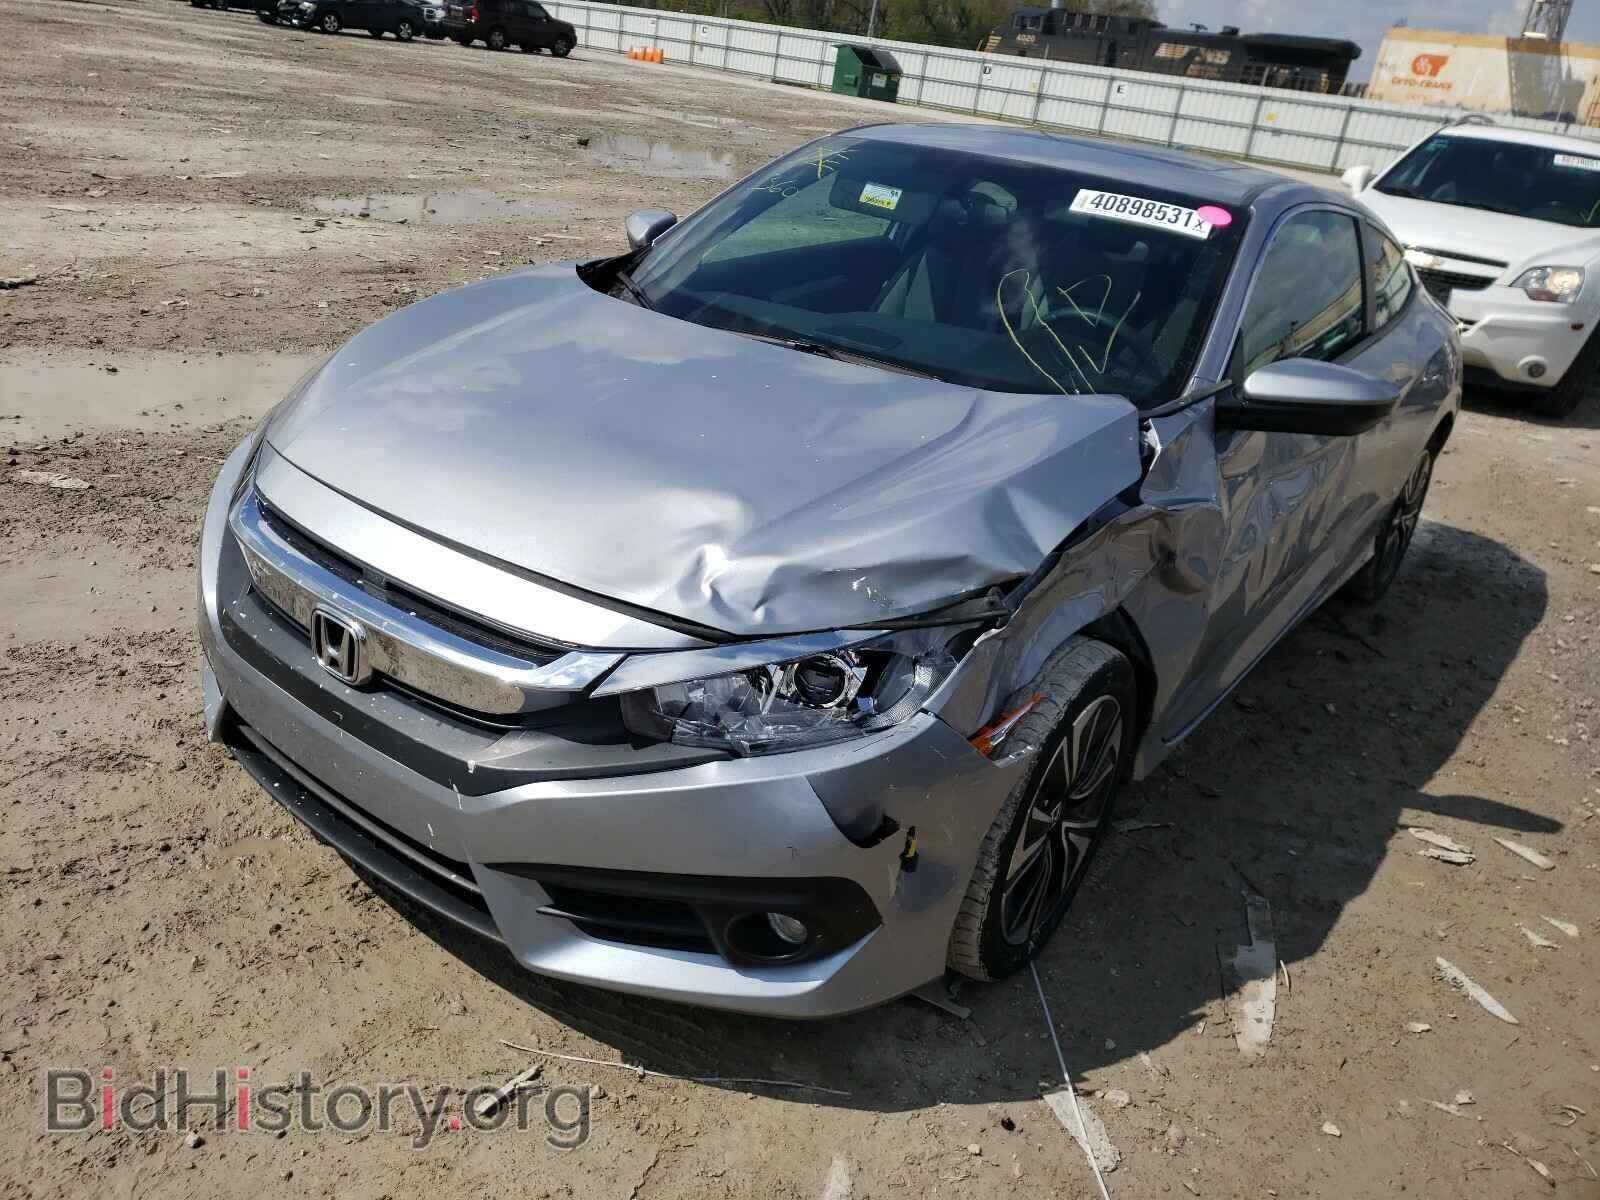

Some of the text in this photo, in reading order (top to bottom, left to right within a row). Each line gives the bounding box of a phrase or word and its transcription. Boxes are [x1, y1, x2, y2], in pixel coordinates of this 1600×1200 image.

[983, 65, 992, 75] D
[1117, 85, 1125, 94] E
[1090, 193, 1195, 228] 40898531
